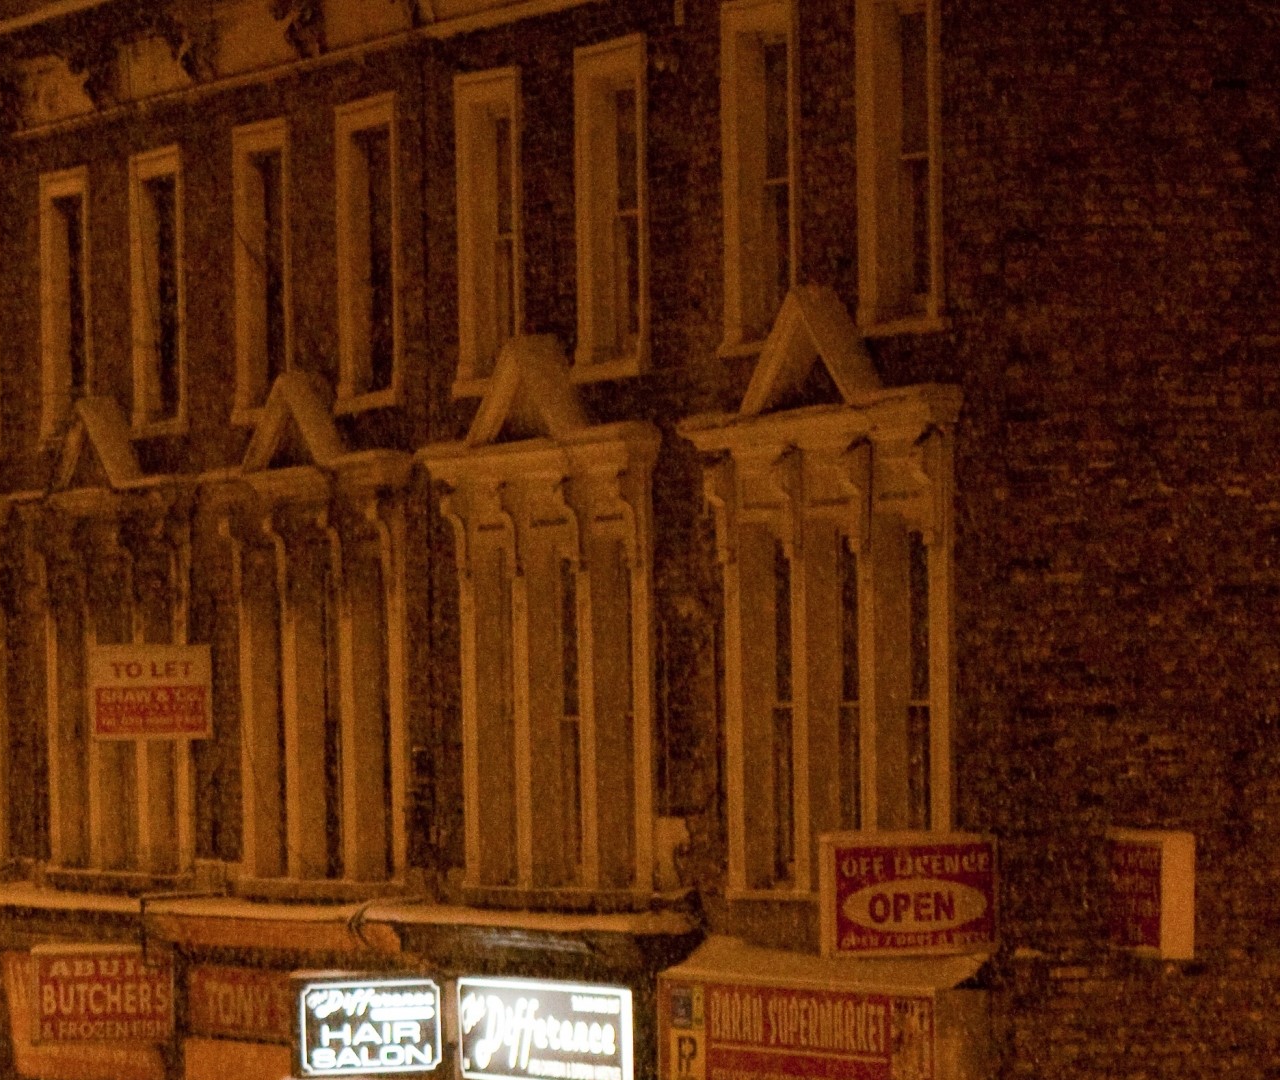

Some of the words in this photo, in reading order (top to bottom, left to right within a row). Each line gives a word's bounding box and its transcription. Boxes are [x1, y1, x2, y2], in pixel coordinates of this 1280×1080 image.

[110, 661, 142, 678] TO
[151, 661, 193, 678] LET
[842, 857, 884, 878] OFF
[894, 853, 990, 876] LICENCE
[869, 892, 954, 924] OPEN
[43, 983, 168, 1015] BUTCHERS
[59, 1021, 129, 1040] FROZEN
[321, 1021, 421, 1047] HAIR
[474, 994, 616, 1069] Difference
[769, 995, 886, 1052] SUPERMARKET
[312, 1044, 432, 1069] SALON
